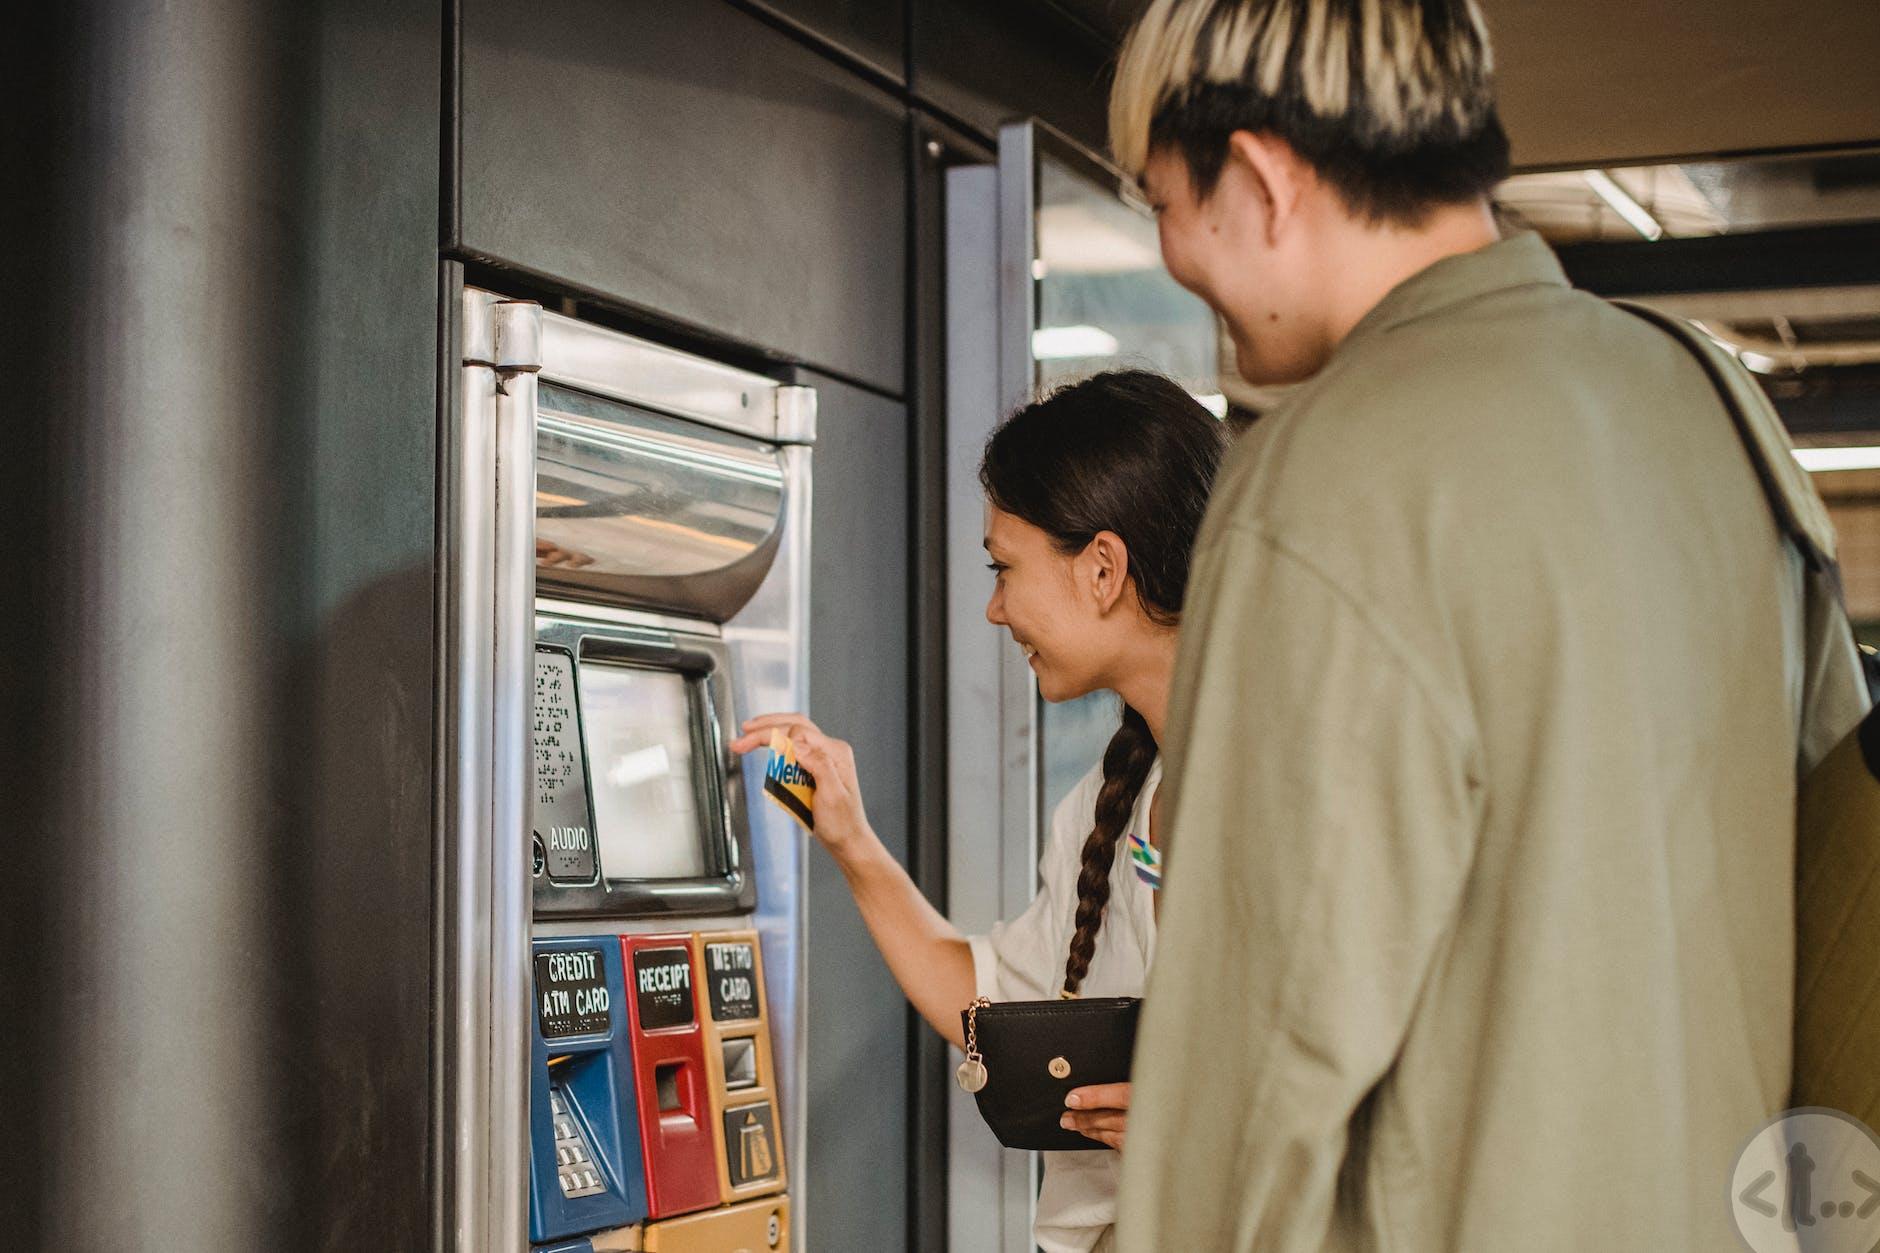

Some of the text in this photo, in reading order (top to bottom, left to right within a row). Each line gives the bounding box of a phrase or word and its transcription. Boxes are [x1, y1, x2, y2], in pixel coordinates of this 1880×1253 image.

[551, 827, 588, 850] AUDIO
[549, 954, 596, 982] CREDIT
[713, 945, 752, 971] METRO
[639, 963, 690, 993] RECEIPT
[720, 977, 751, 1002] CARD
[543, 987, 610, 1017] ATM CARD
